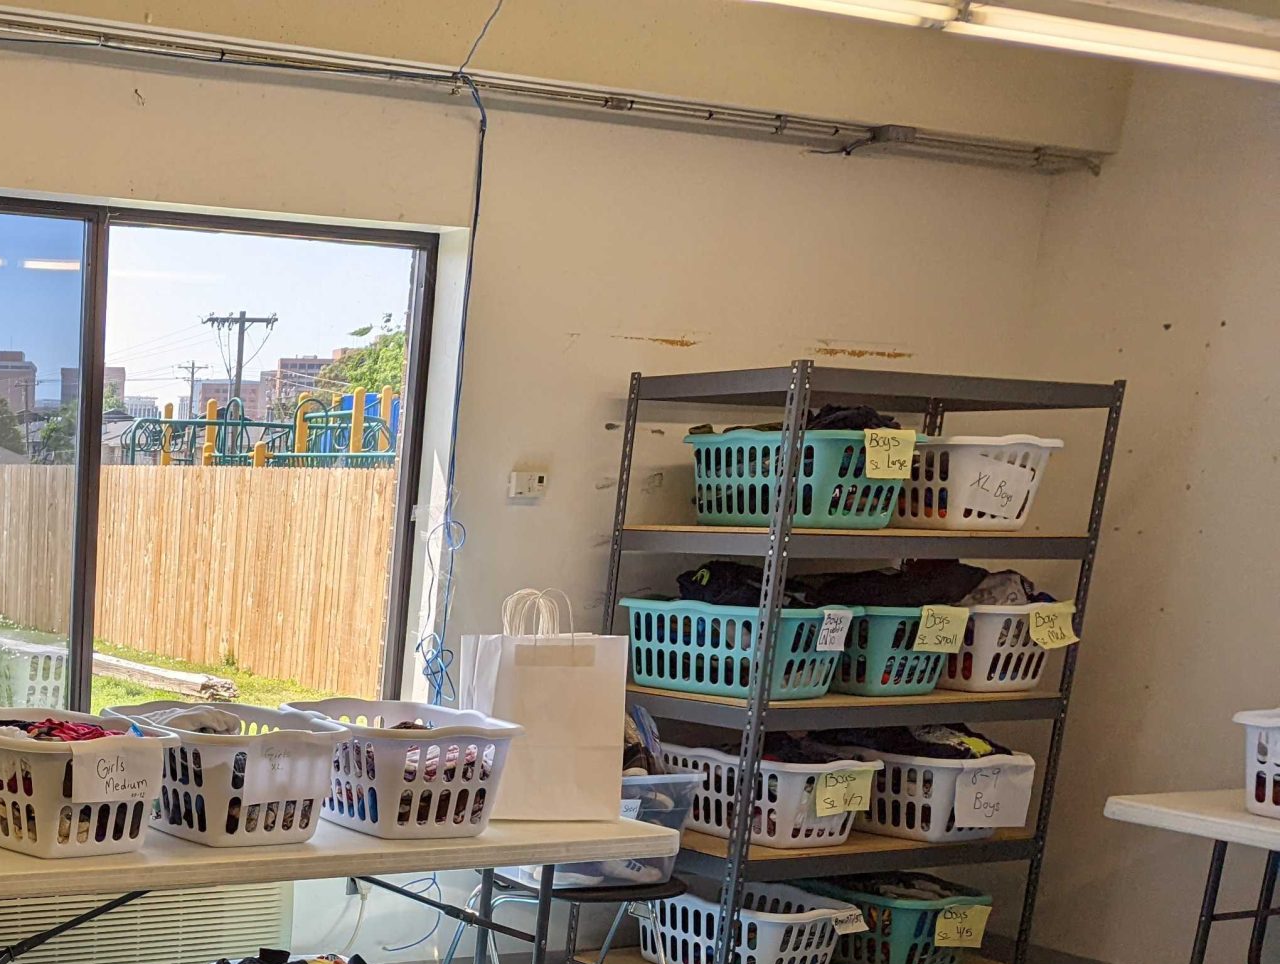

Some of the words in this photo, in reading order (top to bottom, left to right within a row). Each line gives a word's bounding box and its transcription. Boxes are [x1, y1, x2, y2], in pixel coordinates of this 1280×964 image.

[869, 432, 901, 452] Boys
[887, 452, 908, 471] Large
[969, 471, 991, 493] XL
[994, 480, 1013, 508] Boys
[825, 613, 844, 630] Boys
[925, 608, 951, 632] Boys
[1035, 611, 1058, 629] Boys
[96, 755, 125, 780] Girls
[105, 776, 148, 795] Medium
[825, 772, 857, 789] Boys
[973, 791, 1000, 818] Boys
[944, 907, 969, 924] Boys
[956, 925, 973, 939] 4/5
